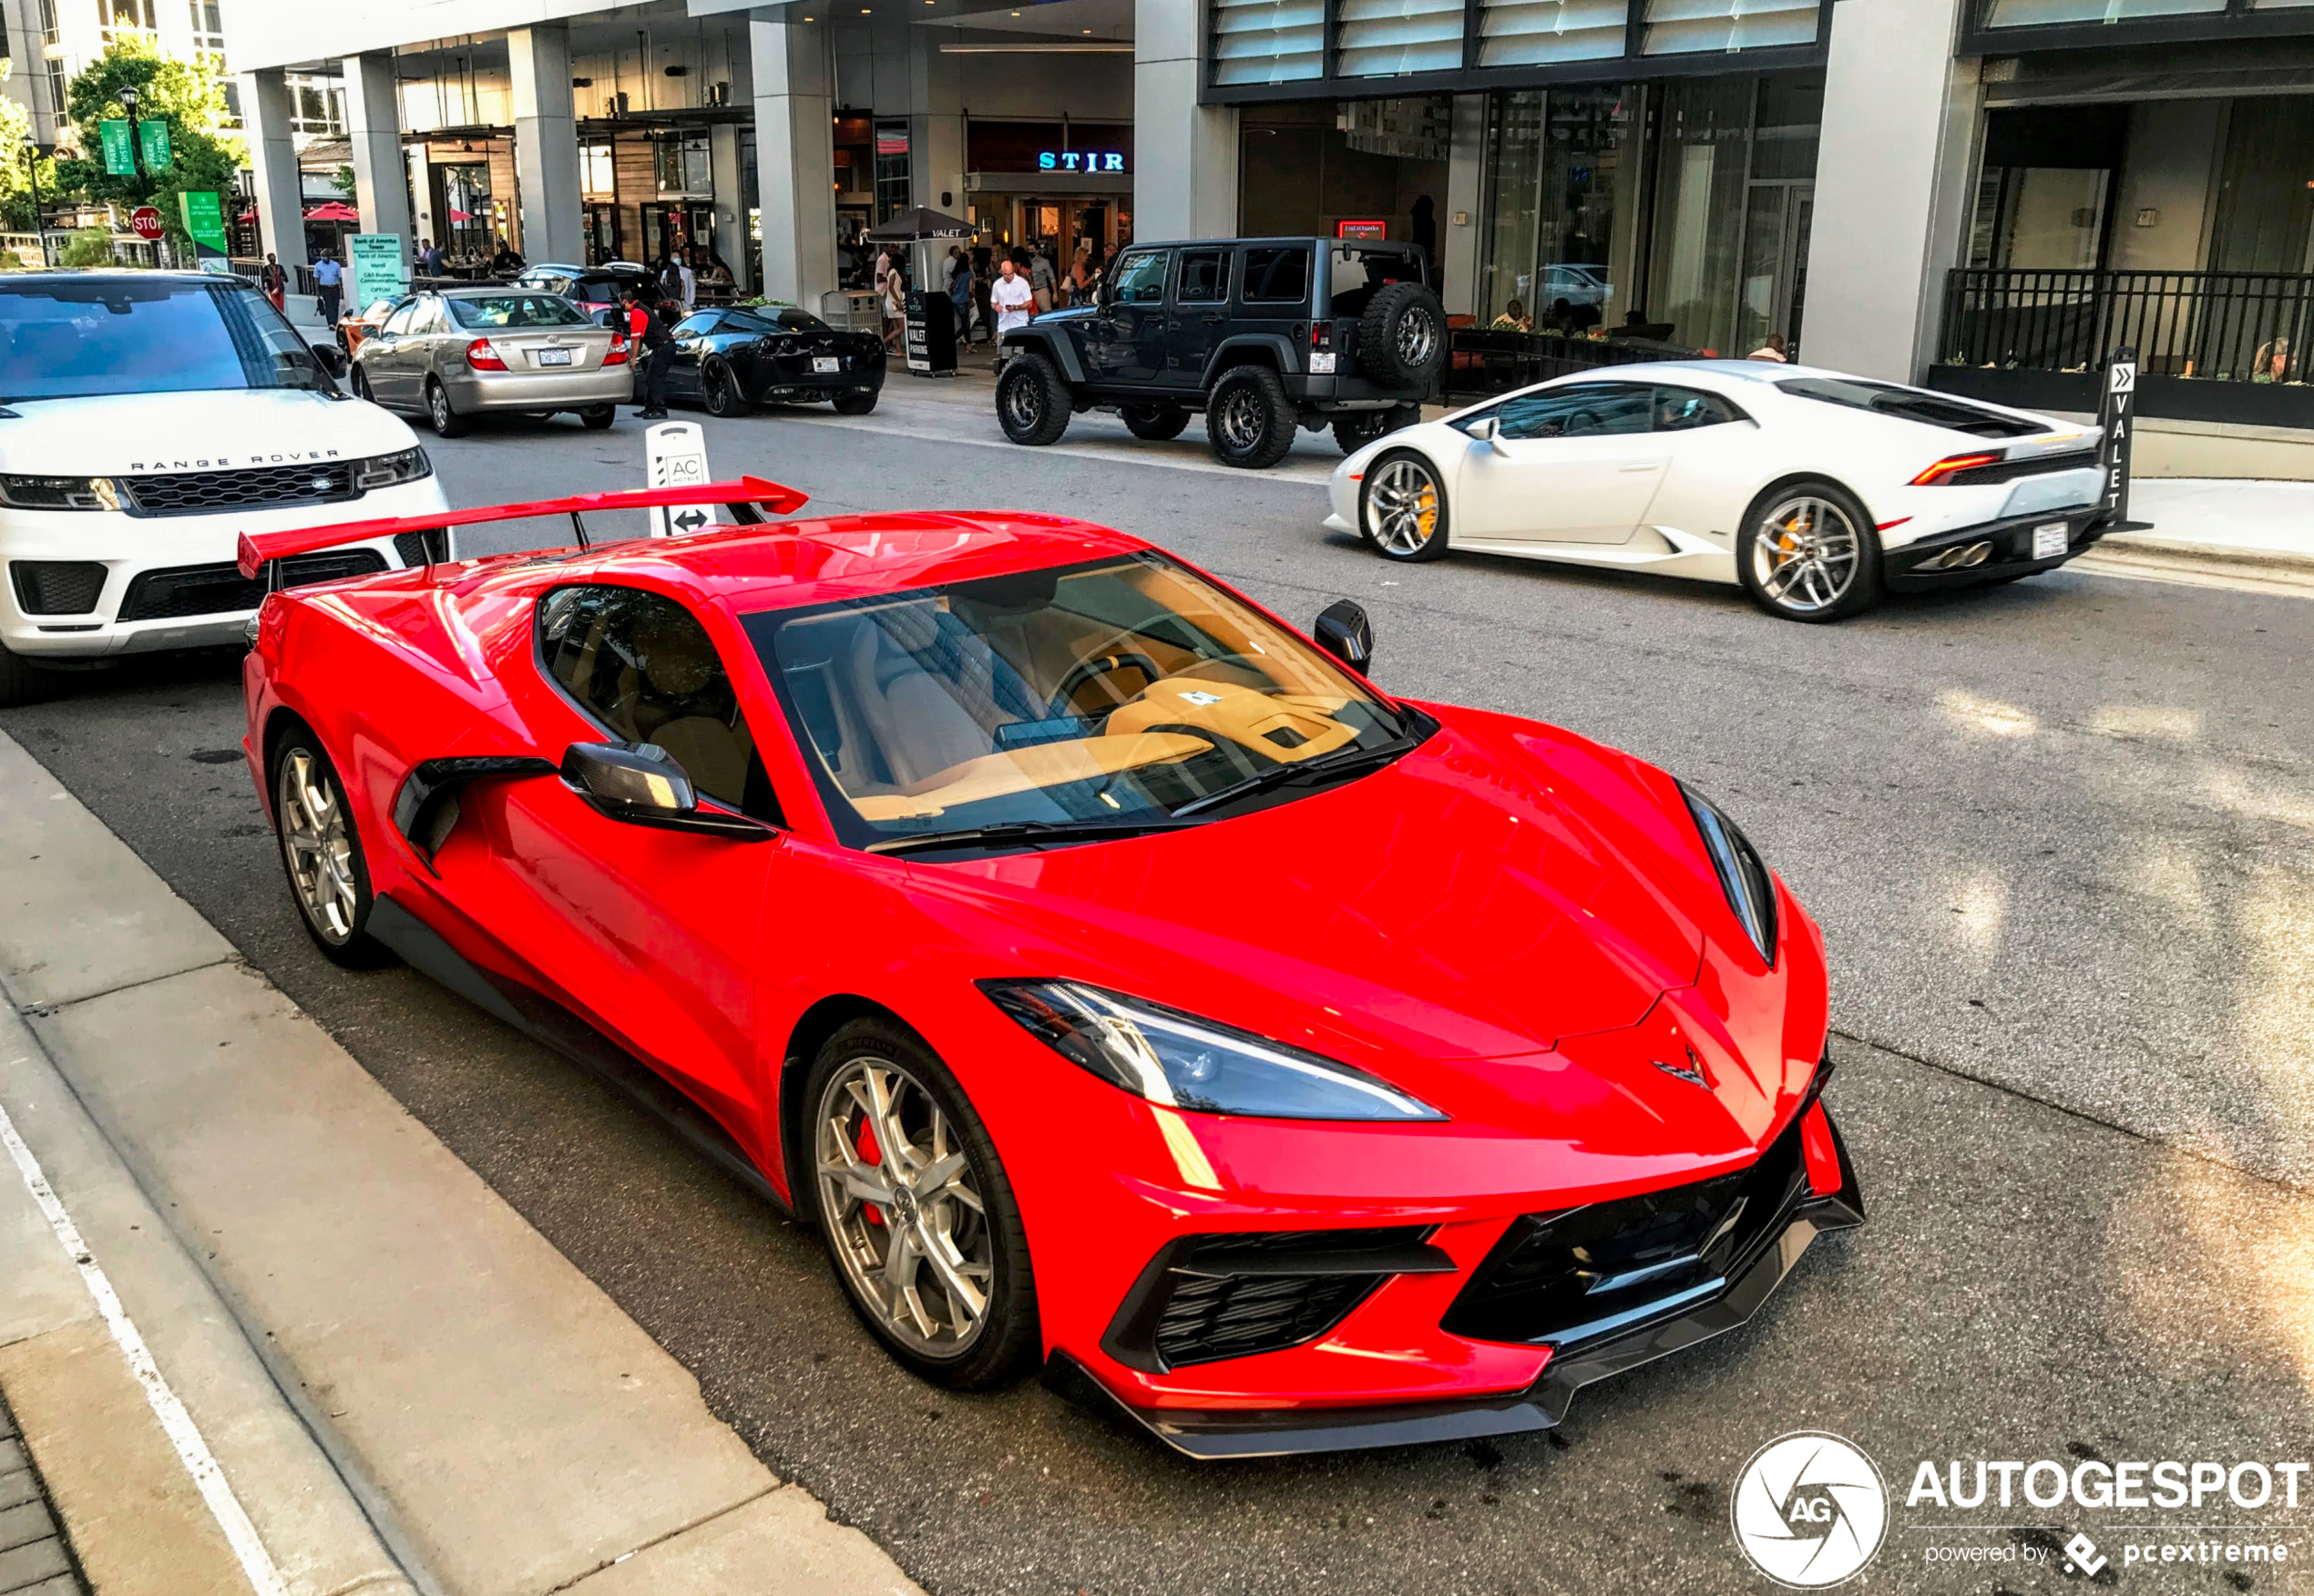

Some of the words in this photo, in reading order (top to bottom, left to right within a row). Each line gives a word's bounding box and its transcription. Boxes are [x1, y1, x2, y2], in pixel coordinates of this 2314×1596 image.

[108, 142, 118, 162] PARK
[117, 129, 128, 162] DISTRICT
[147, 142, 156, 162] PARK
[1039, 152, 1124, 172] STIR
[932, 229, 961, 238] VALET
[908, 329, 926, 342] VALET
[910, 344, 928, 355] PARKING
[131, 457, 230, 470] RANGE
[251, 449, 340, 464] ROVER
[2108, 394, 2128, 508] VALET
[673, 459, 699, 476] AC
